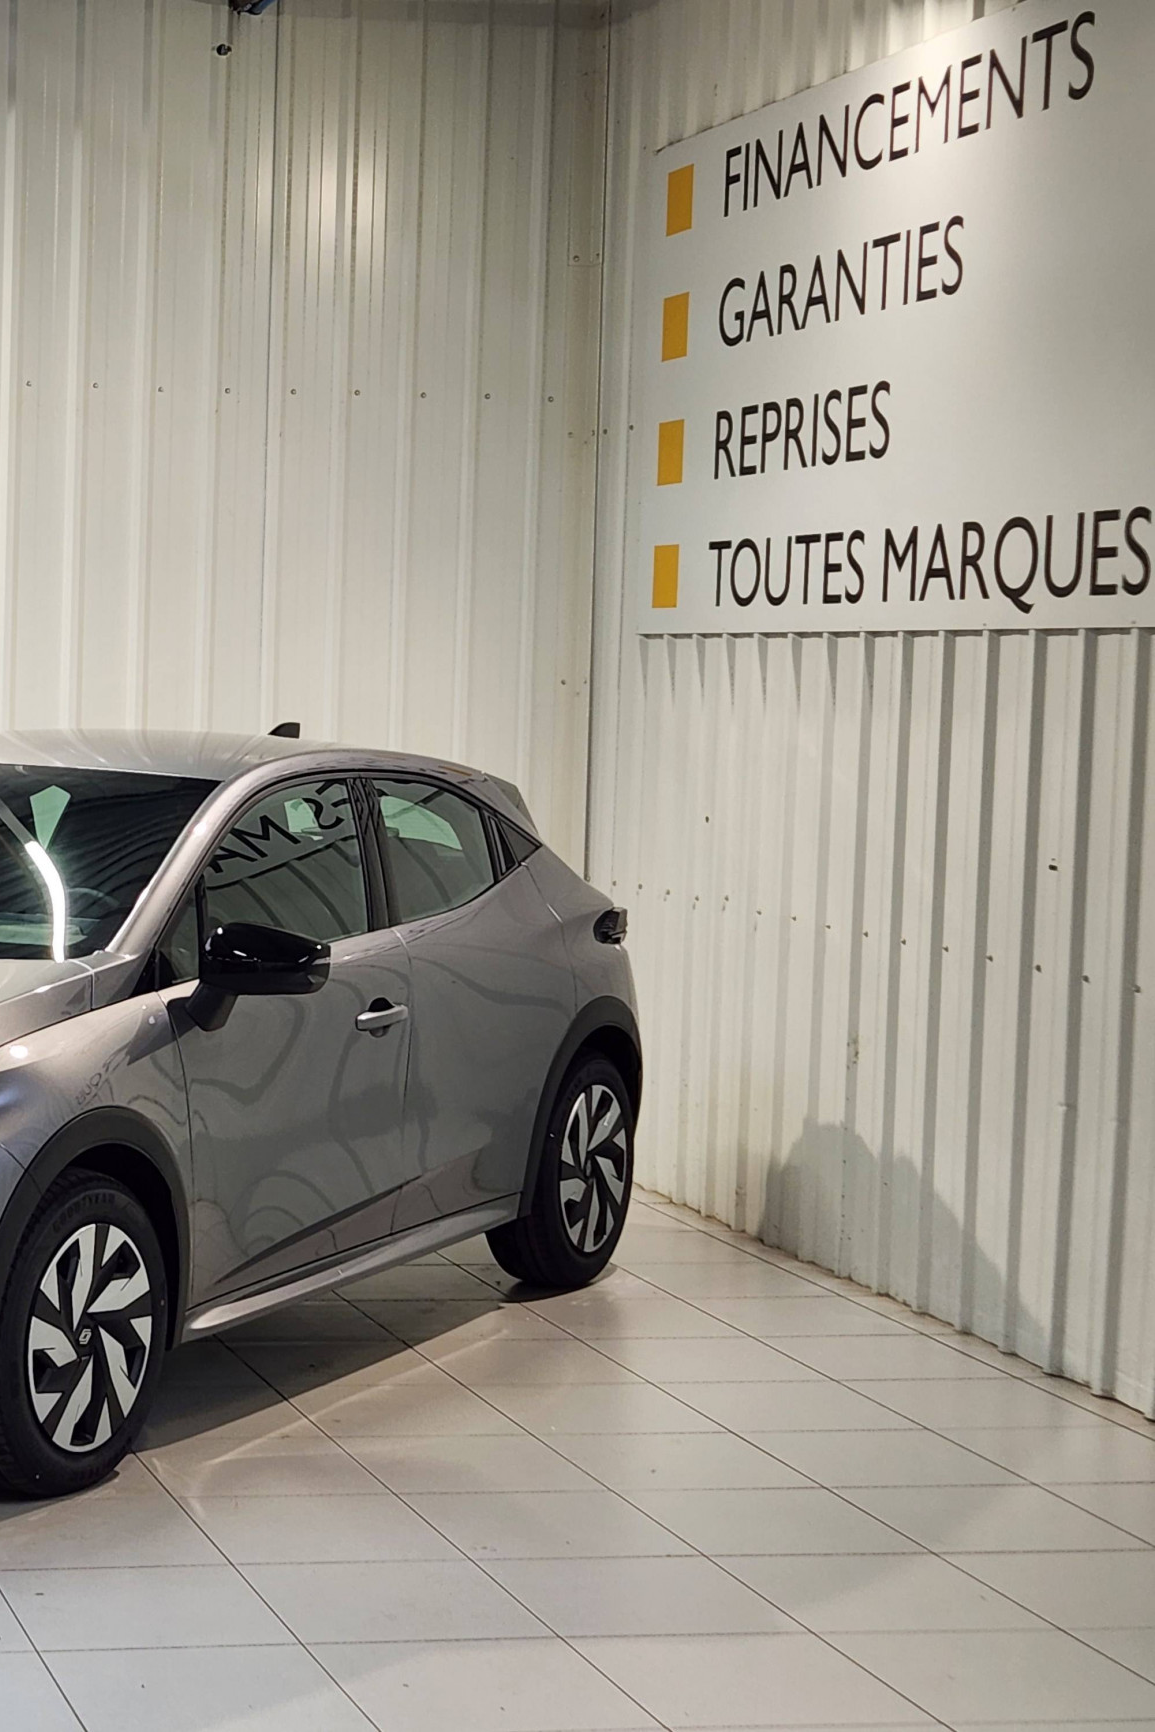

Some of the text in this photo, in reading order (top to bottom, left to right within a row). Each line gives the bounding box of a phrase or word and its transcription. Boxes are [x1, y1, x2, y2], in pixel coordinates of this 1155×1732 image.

[723, 11, 1095, 217] FINANCEMENTS
[718, 215, 964, 347] GARANTIES
[713, 380, 891, 480] REPRISES
[709, 506, 1152, 614] TOUTES MARQUES
